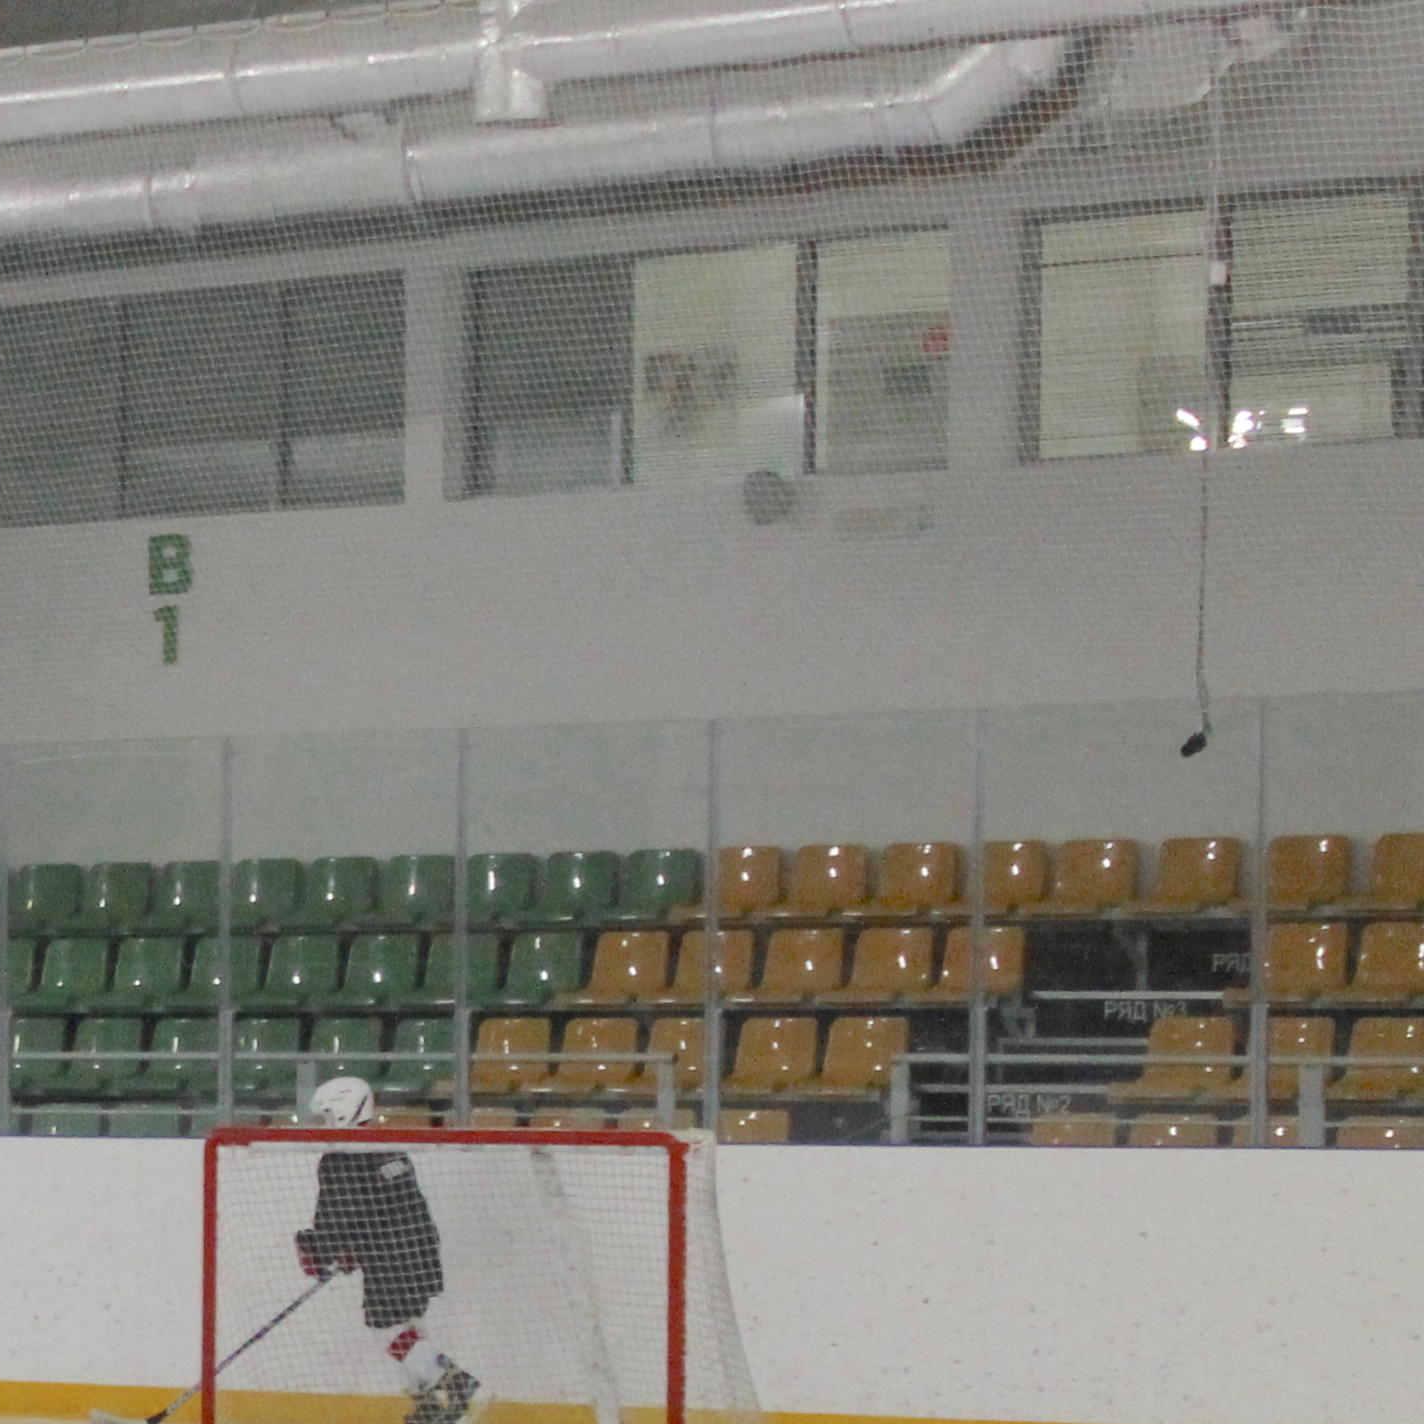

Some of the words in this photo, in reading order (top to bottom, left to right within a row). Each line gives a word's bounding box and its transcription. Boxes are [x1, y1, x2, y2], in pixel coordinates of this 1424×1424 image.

[153, 605, 178, 664] 1
[1104, 1000, 1148, 1023] РЯД
[988, 1094, 1031, 1119] РЯД
